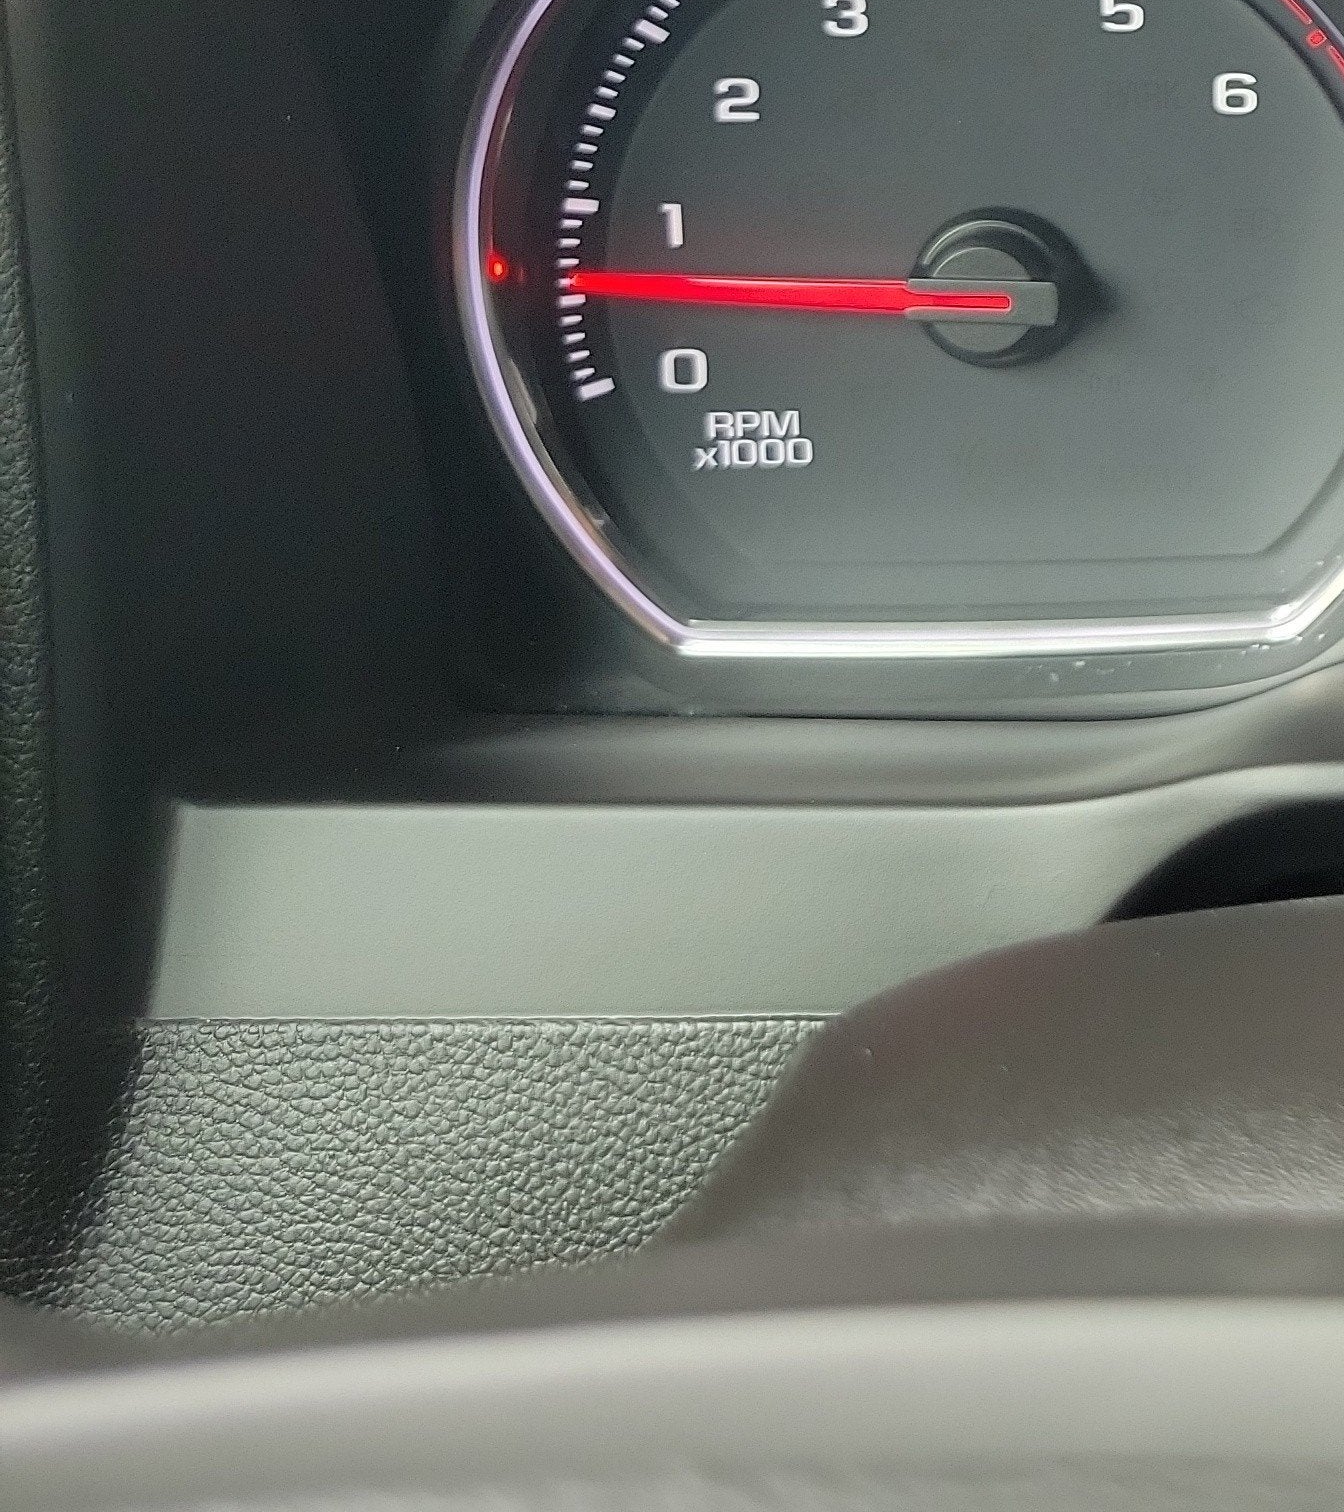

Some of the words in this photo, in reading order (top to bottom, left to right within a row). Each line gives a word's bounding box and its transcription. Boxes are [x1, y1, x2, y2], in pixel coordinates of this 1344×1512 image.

[714, 77, 760, 123] 2
[1212, 72, 1258, 115] 6
[660, 203, 684, 248] 1
[660, 348, 708, 393] 0
[706, 409, 800, 438] RPM
[695, 437, 813, 469] x1000
